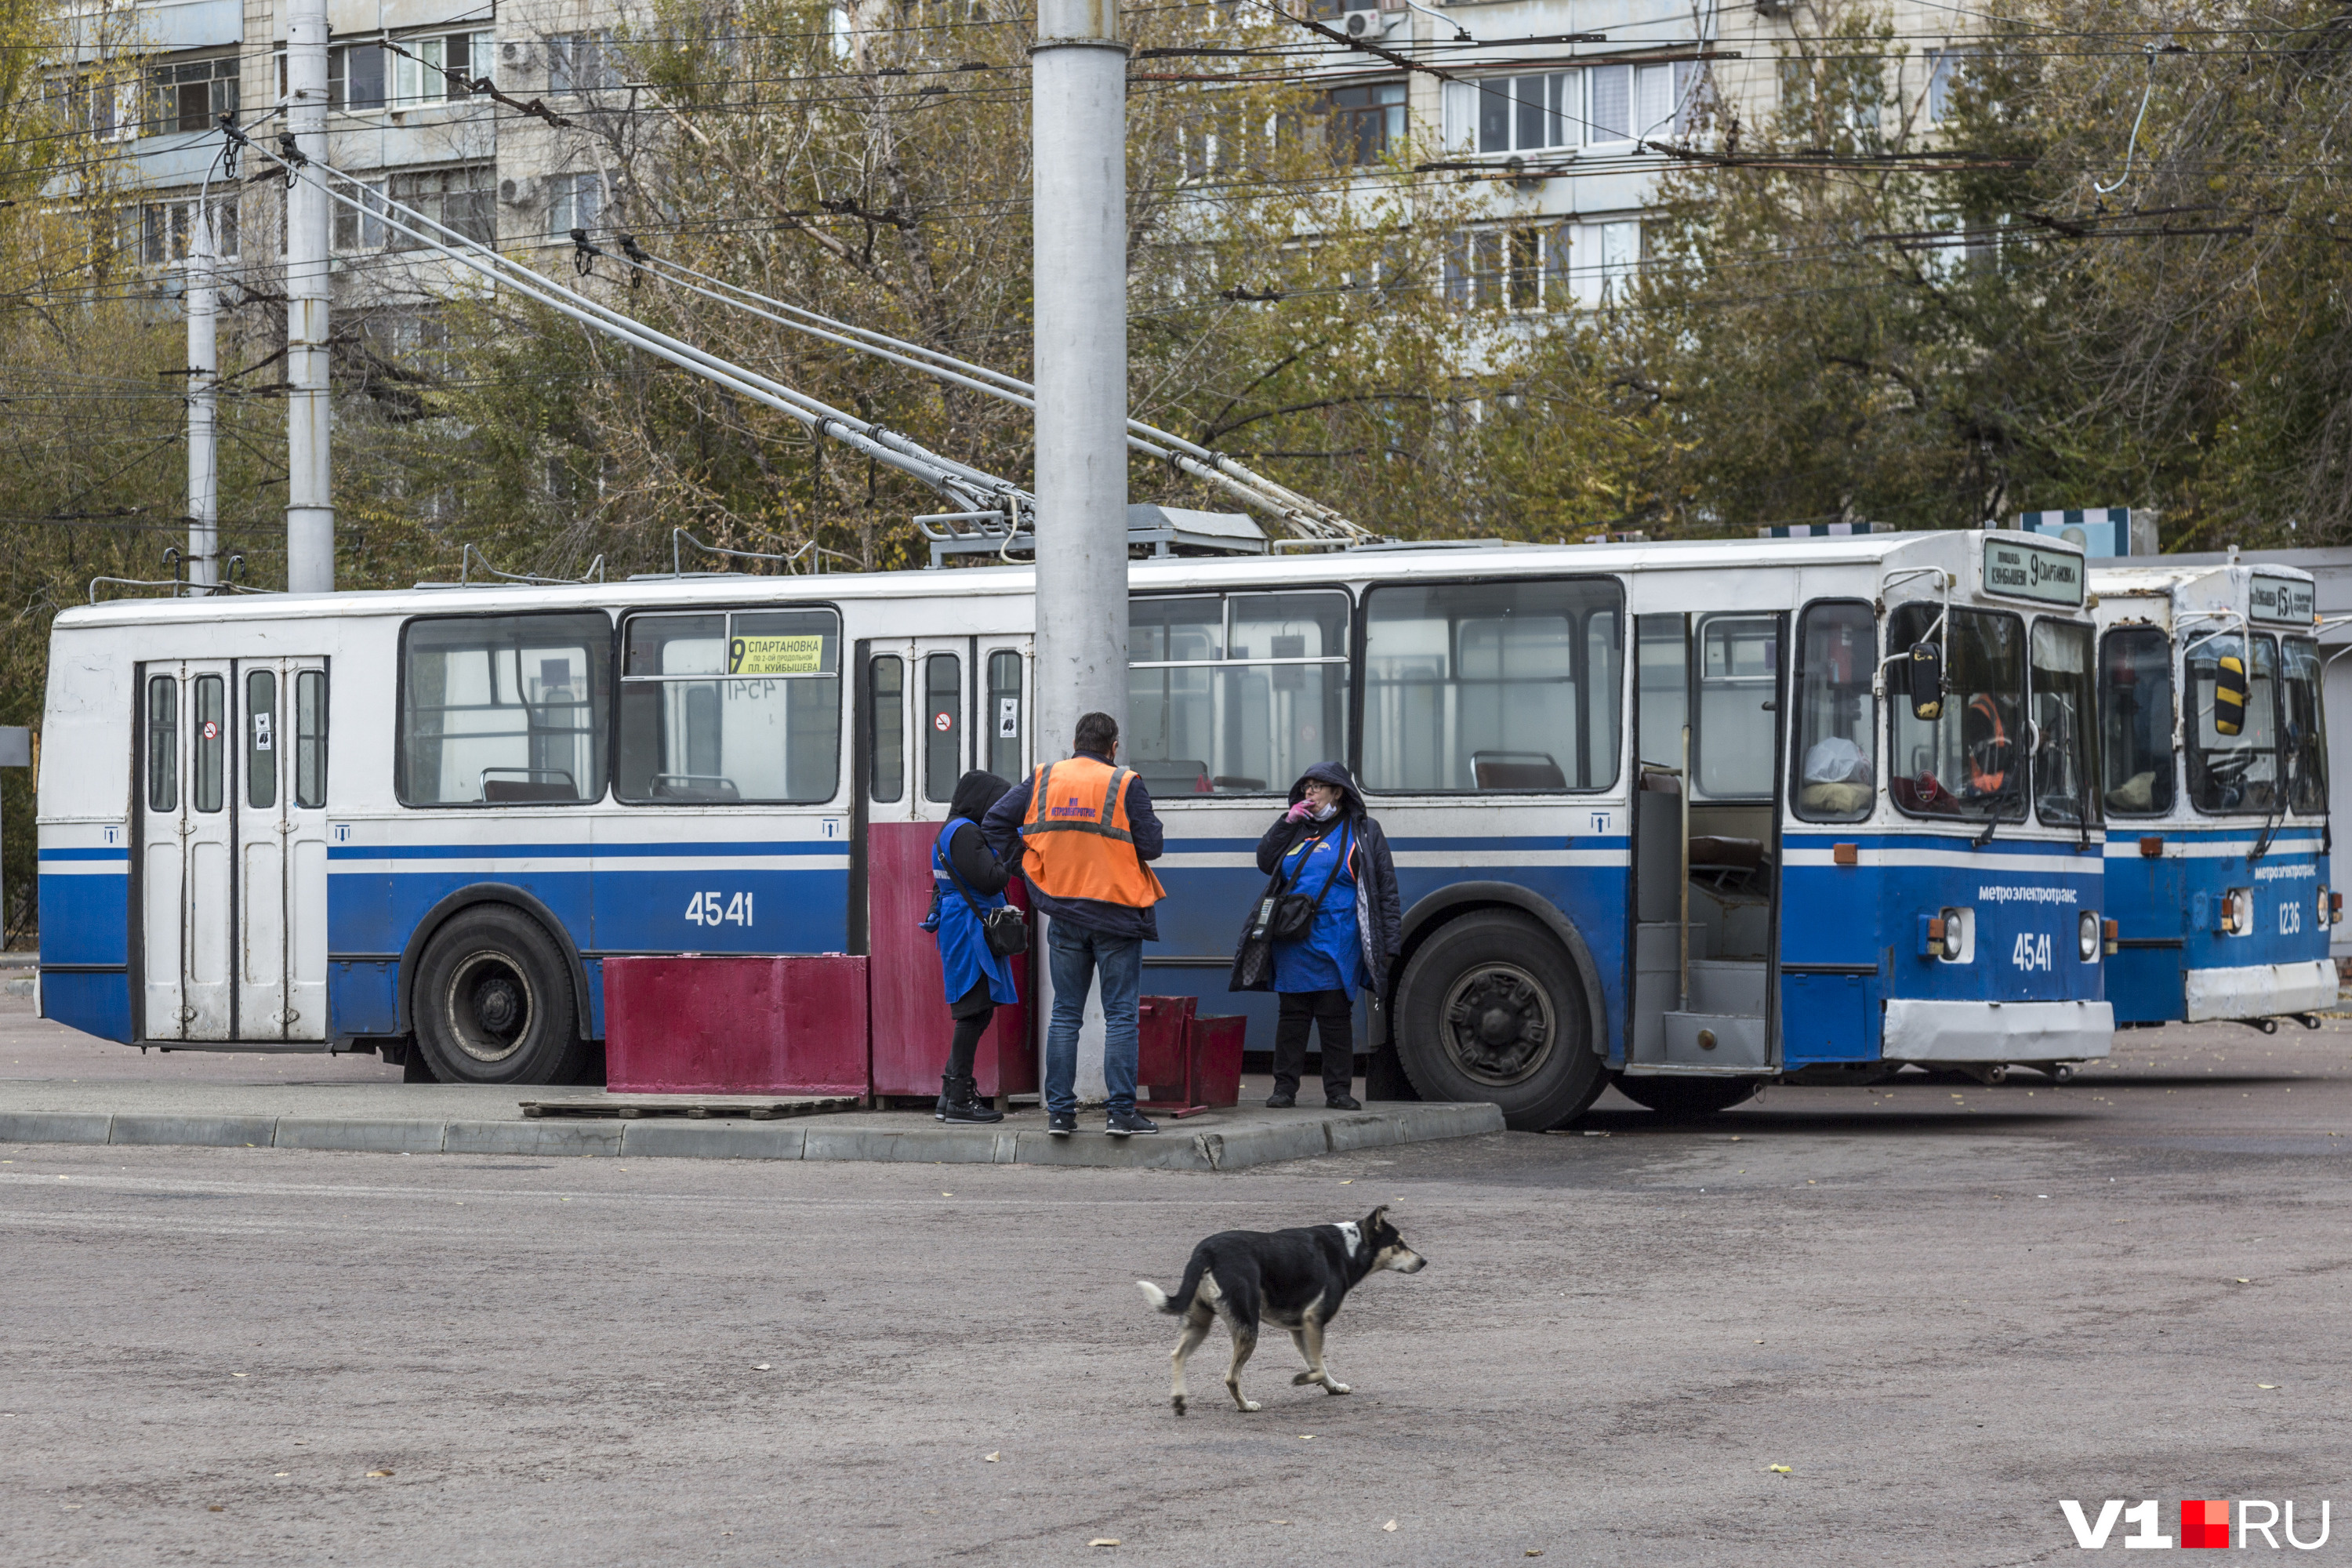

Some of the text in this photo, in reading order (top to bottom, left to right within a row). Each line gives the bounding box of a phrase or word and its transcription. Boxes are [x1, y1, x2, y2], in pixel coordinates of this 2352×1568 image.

[2031, 554, 2038, 586] 9
[2040, 561, 2076, 583] СПАРТАНОВКА
[730, 639, 746, 674] 9
[749, 641, 818, 653] СПАРТАНОВКА
[777, 653, 813, 662] ПРОДОЛЬНОЙ
[748, 662, 818, 673] ПЛ. КУЙБЫШЕВА
[684, 891, 753, 926] 4541
[1979, 885, 2078, 905] метроэлектротранс
[2279, 902, 2300, 935] 1236
[2013, 933, 2052, 971] 4541
